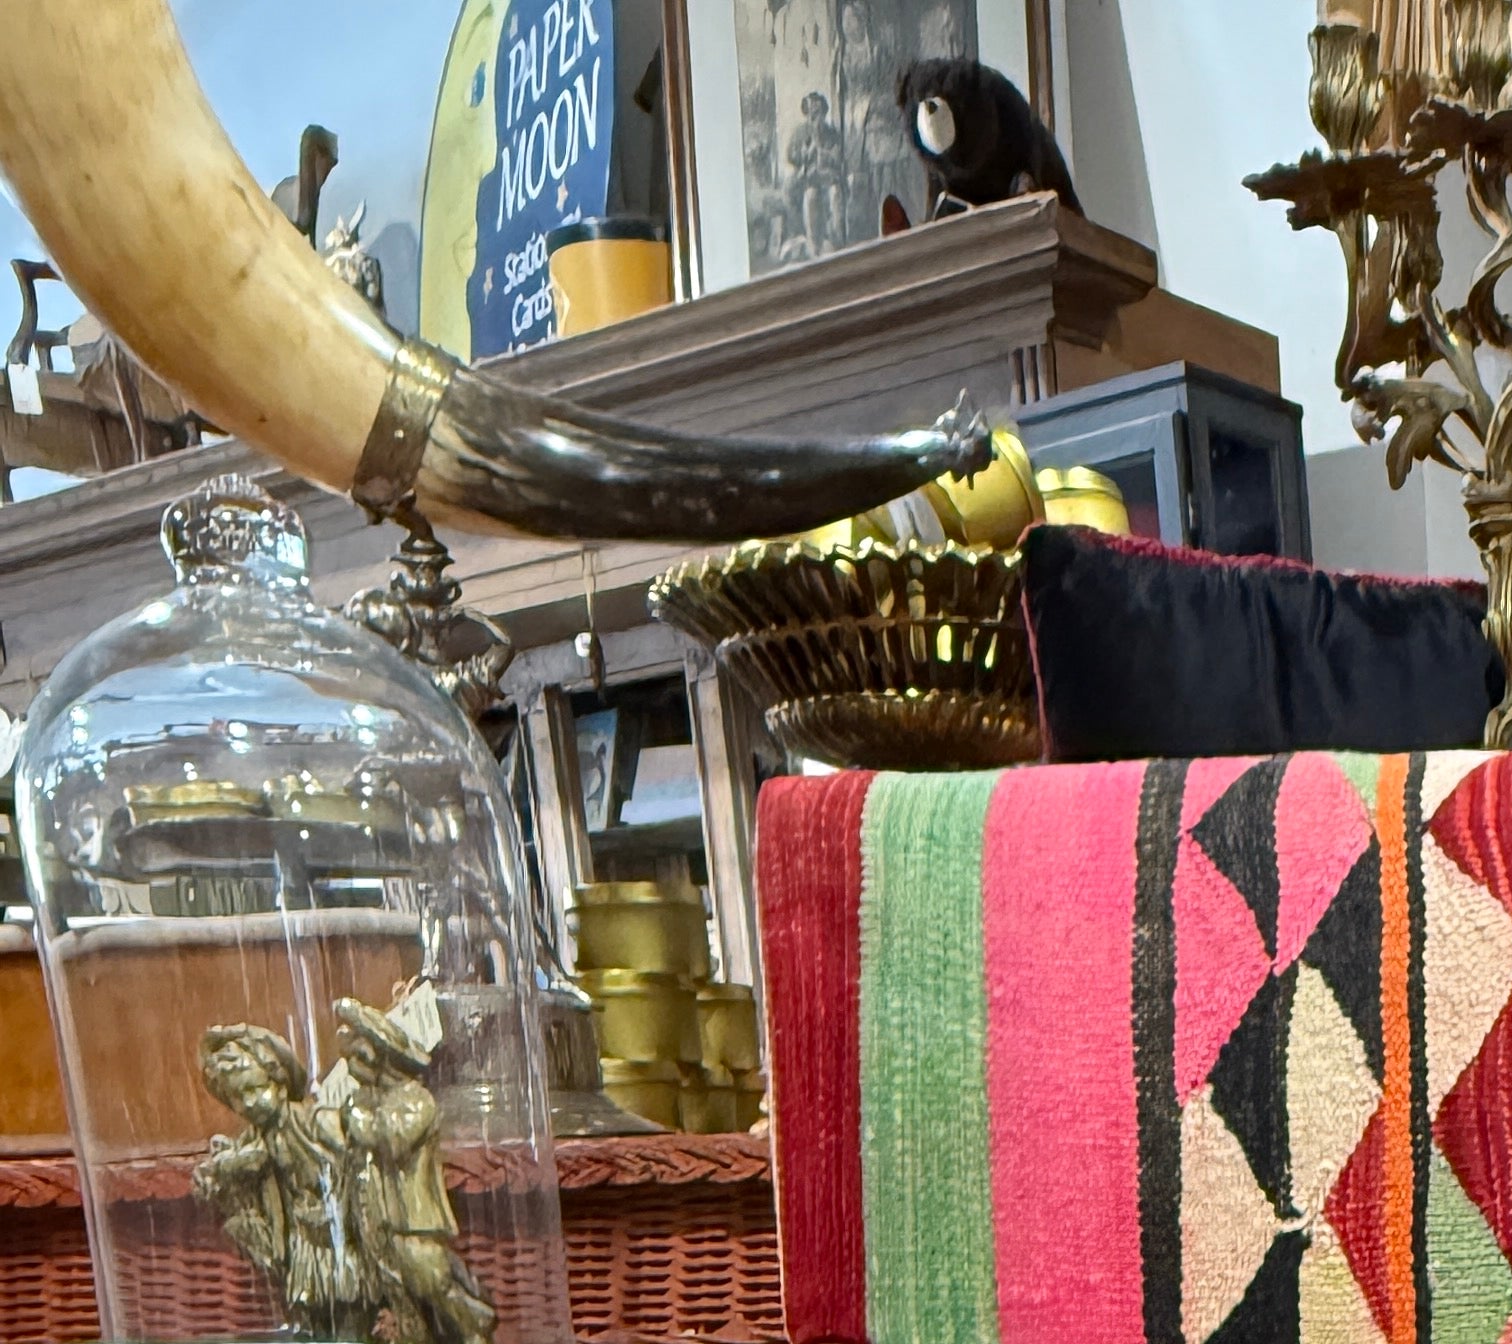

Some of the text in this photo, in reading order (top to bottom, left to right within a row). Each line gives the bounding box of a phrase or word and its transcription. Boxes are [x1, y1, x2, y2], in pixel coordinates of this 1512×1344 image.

[507, 0, 600, 129] PAPER
[496, 56, 601, 232] MOON
[504, 230, 549, 295] Statio
